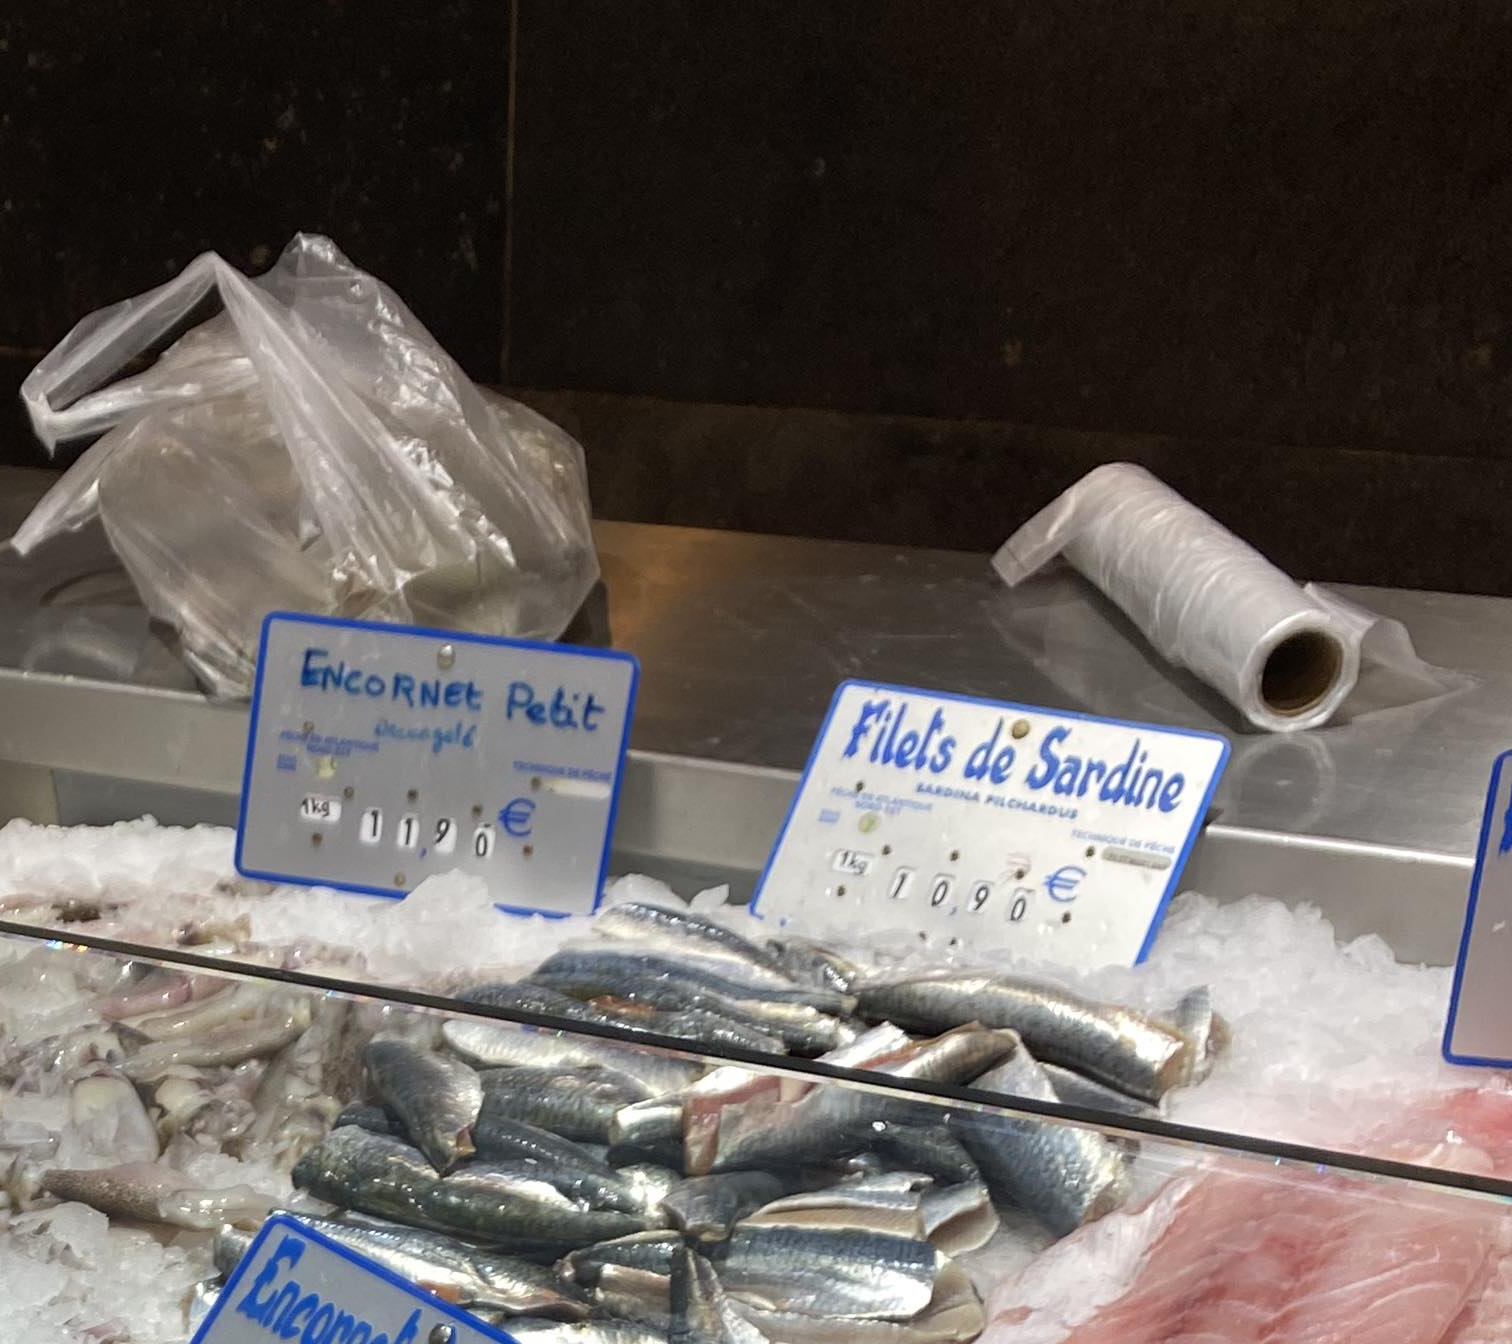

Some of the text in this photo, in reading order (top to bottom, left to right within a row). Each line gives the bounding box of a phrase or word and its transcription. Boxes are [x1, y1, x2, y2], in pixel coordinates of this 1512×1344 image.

[506, 681, 605, 732] Petit
[843, 698, 1186, 813] Filets de Sardine
[301, 797, 330, 817] 1kg
[498, 797, 536, 837] €
[840, 851, 866, 875] 1kg
[1043, 866, 1087, 902] €
